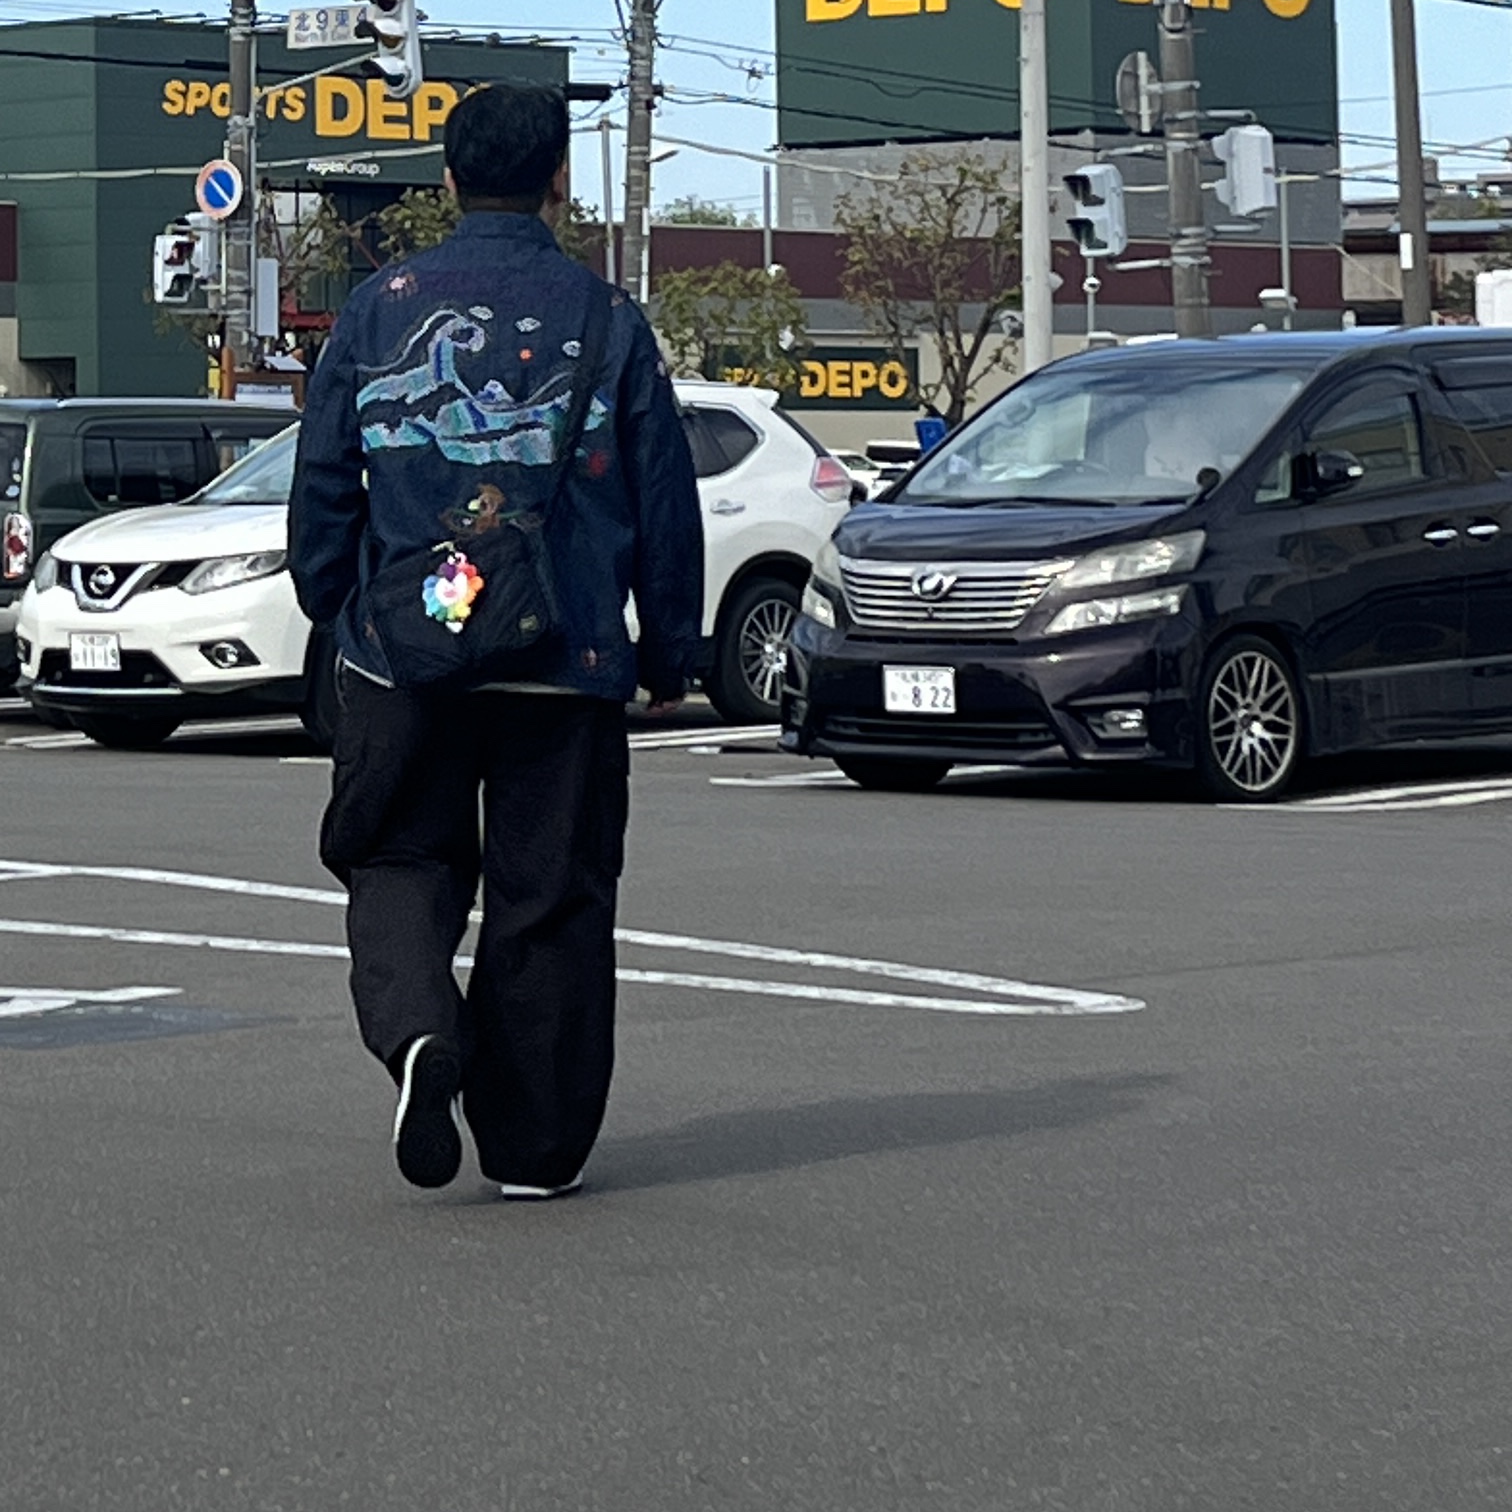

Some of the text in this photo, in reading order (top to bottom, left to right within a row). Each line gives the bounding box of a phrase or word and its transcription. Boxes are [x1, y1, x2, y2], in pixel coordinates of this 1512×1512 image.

[162, 75, 492, 141] SPOTS DEP
[800, 360, 908, 399] DEPO
